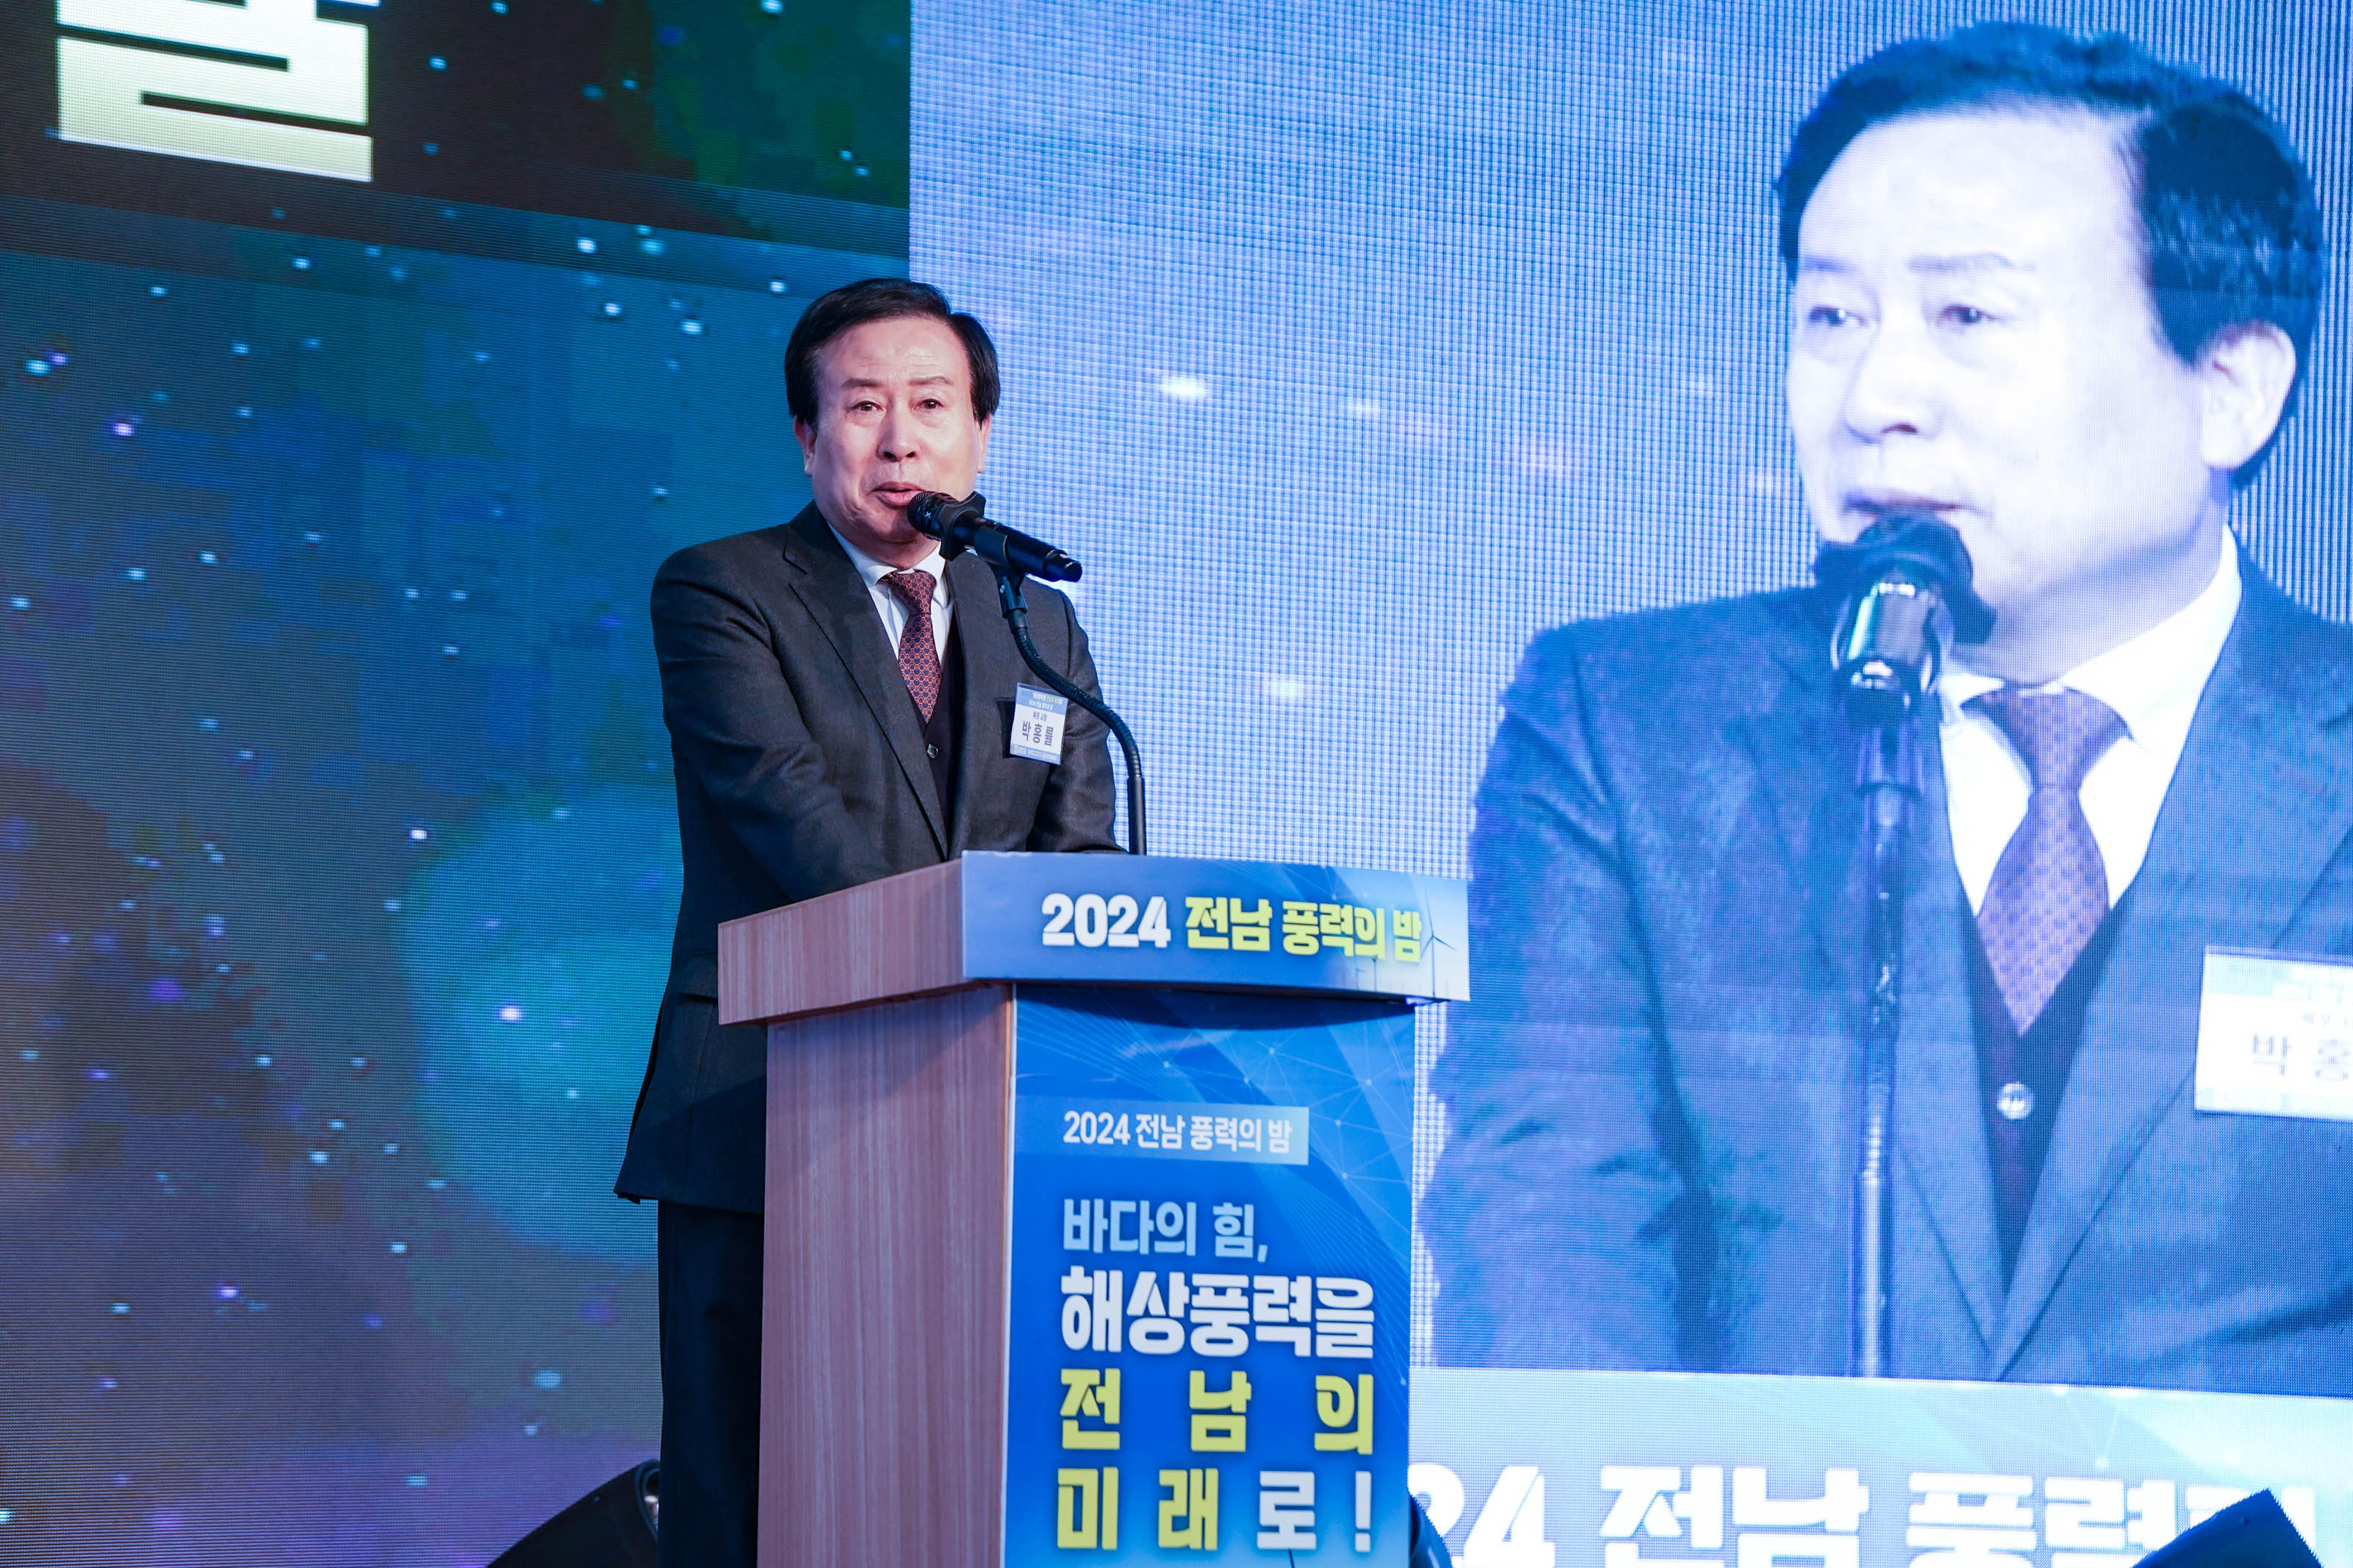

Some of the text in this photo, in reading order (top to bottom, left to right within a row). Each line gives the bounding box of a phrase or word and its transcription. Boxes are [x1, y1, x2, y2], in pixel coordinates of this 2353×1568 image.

[1041, 892, 1423, 963] 2024 전남 풍력의 밤
[1063, 1110, 1293, 1154] 2024 전남 풍력의 밤
[1063, 1198, 1268, 1263] 바다의 힘,
[1060, 1265, 1374, 1358] 해상풍력을
[1060, 1368, 1374, 1456] 전남의
[1599, 1464, 1870, 1568] 전남
